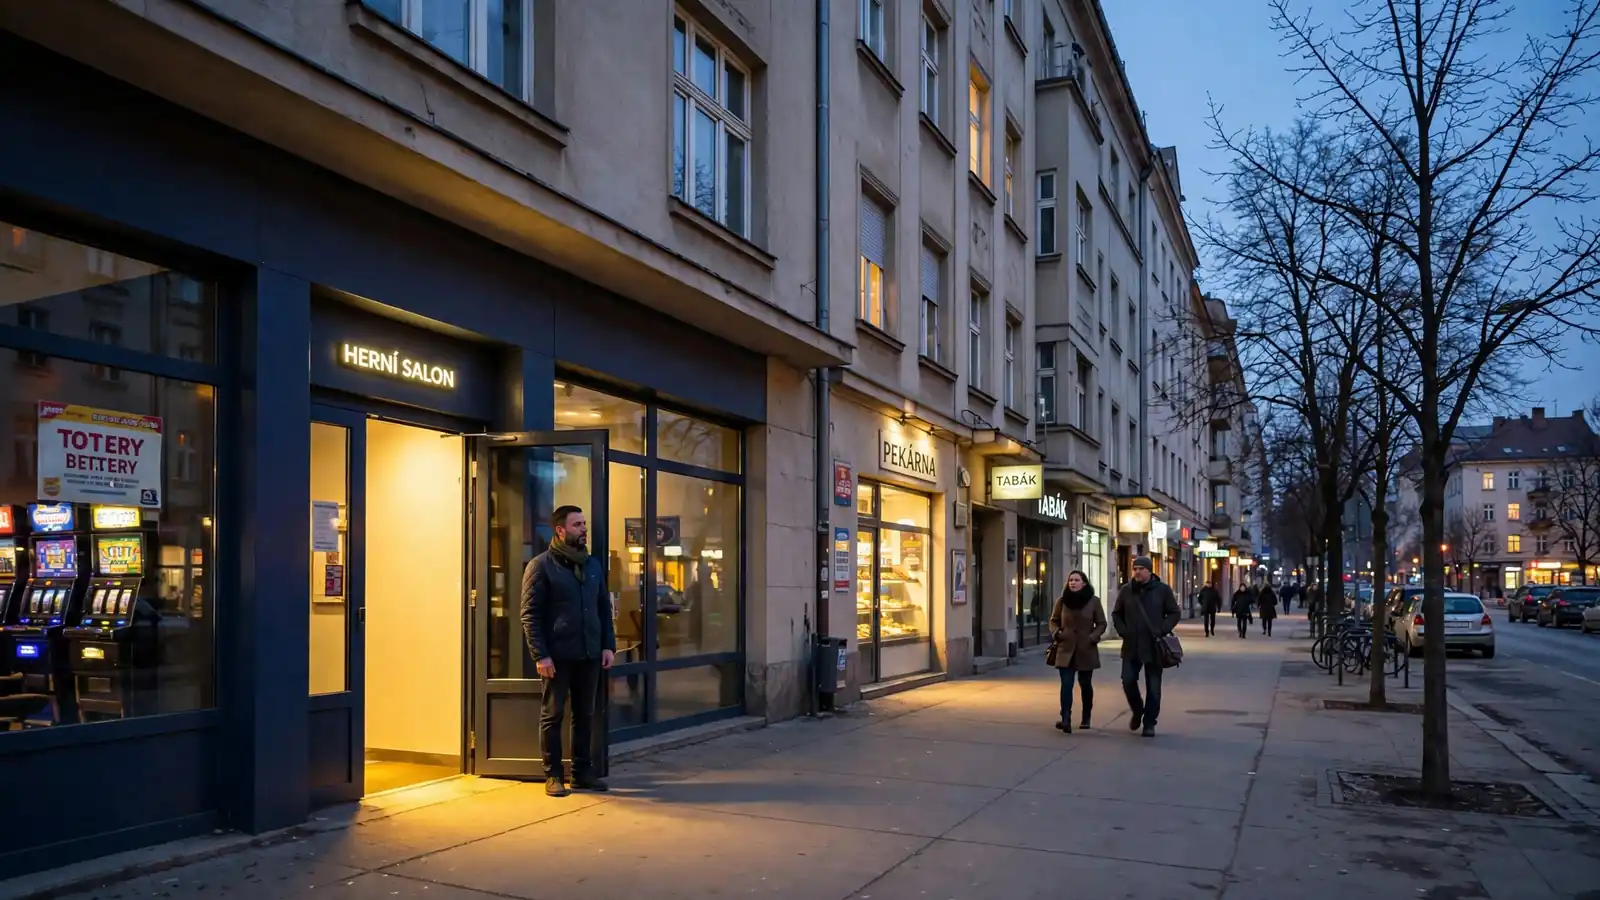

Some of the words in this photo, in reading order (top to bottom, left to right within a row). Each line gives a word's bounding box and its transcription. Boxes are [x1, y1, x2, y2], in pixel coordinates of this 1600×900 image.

[344, 343, 399, 375] HERNÍ
[402, 358, 455, 388] SALON
[57, 428, 145, 457] TOTERY
[883, 440, 936, 477] PEKÁRNA
[996, 472, 1037, 487] TABÁK
